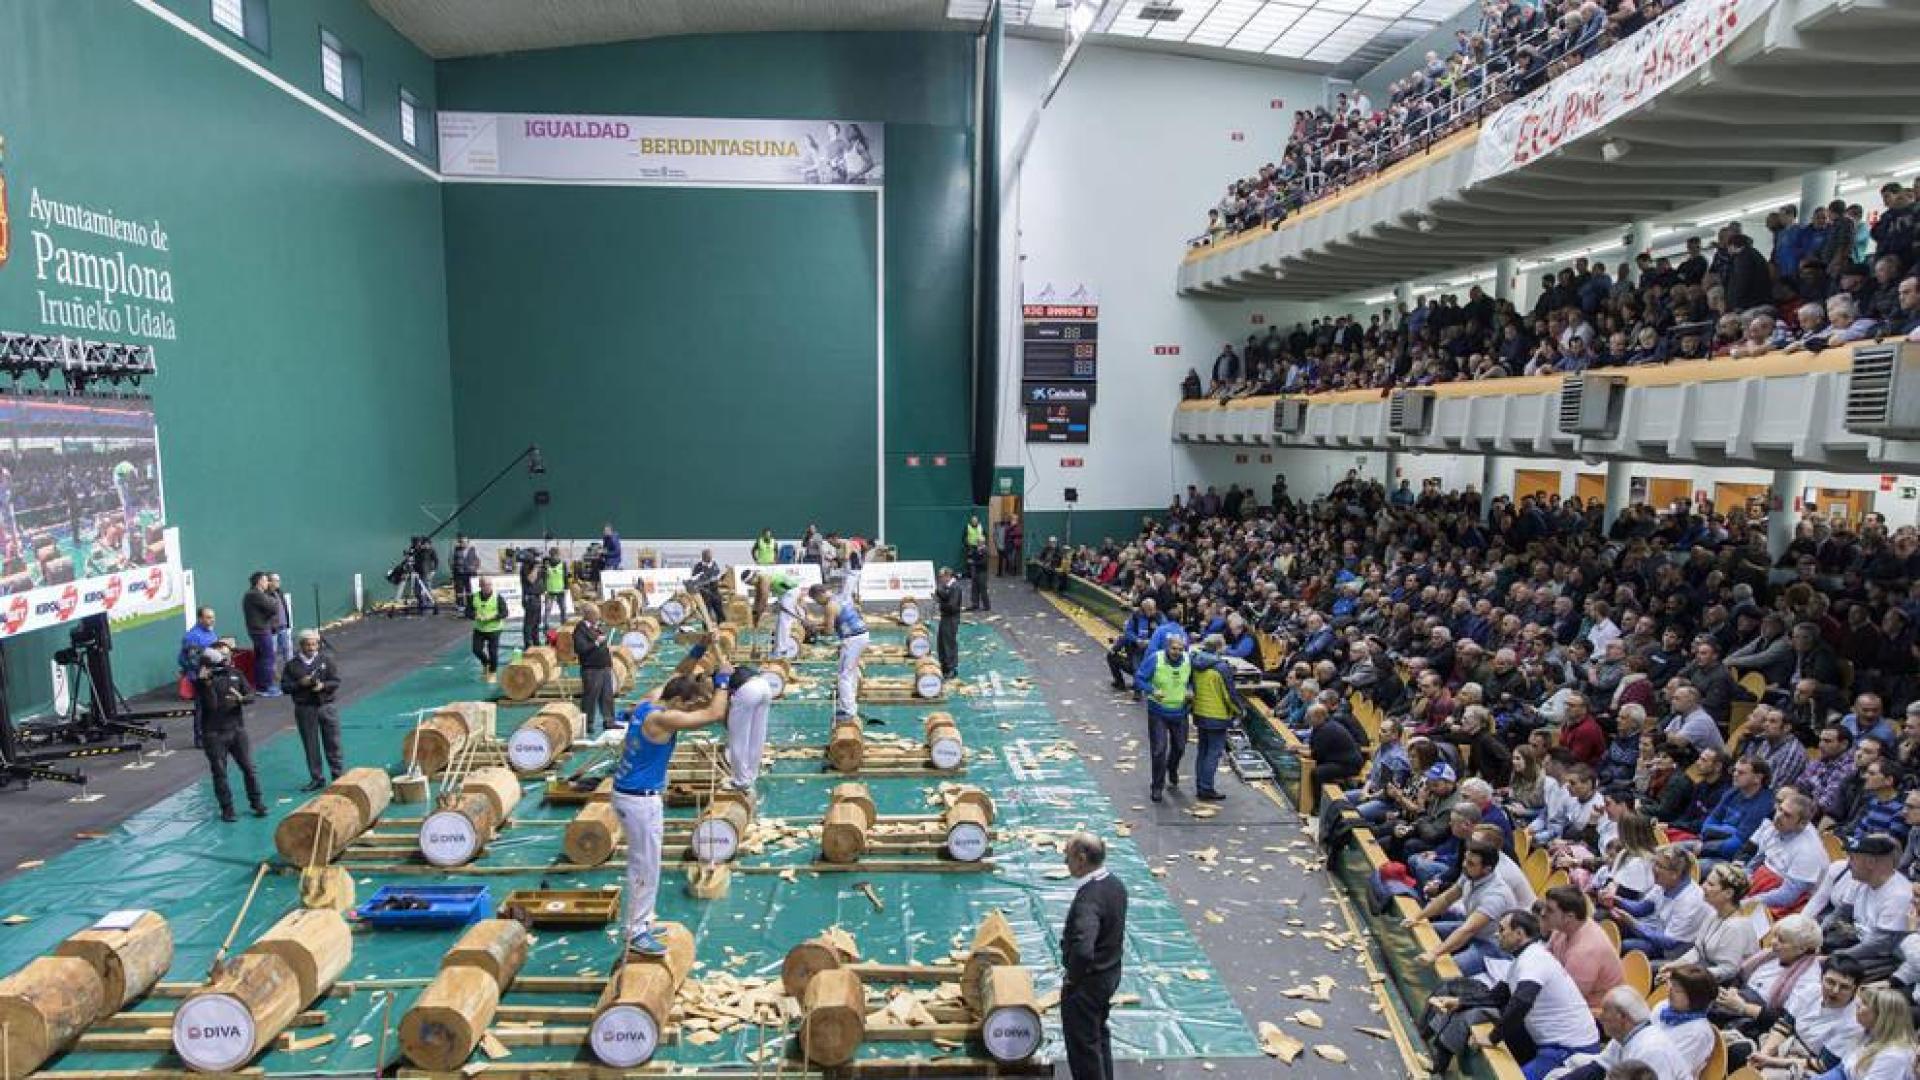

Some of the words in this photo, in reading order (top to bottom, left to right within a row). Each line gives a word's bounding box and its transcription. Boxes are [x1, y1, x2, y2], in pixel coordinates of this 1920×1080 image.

[524, 119, 630, 139] IGUALDAD
[640, 137, 800, 157] BERDINTASUNA
[30, 186, 148, 247] Ayuntamiento
[150, 220, 169, 251] de
[31, 230, 174, 304] Pamplona
[37, 289, 122, 334] Iruñeko
[125, 303, 177, 341] Udala
[203, 1024, 241, 1039] DIVA
[616, 1030, 647, 1042] DIVA
[1004, 1027, 1031, 1039] DIVA
